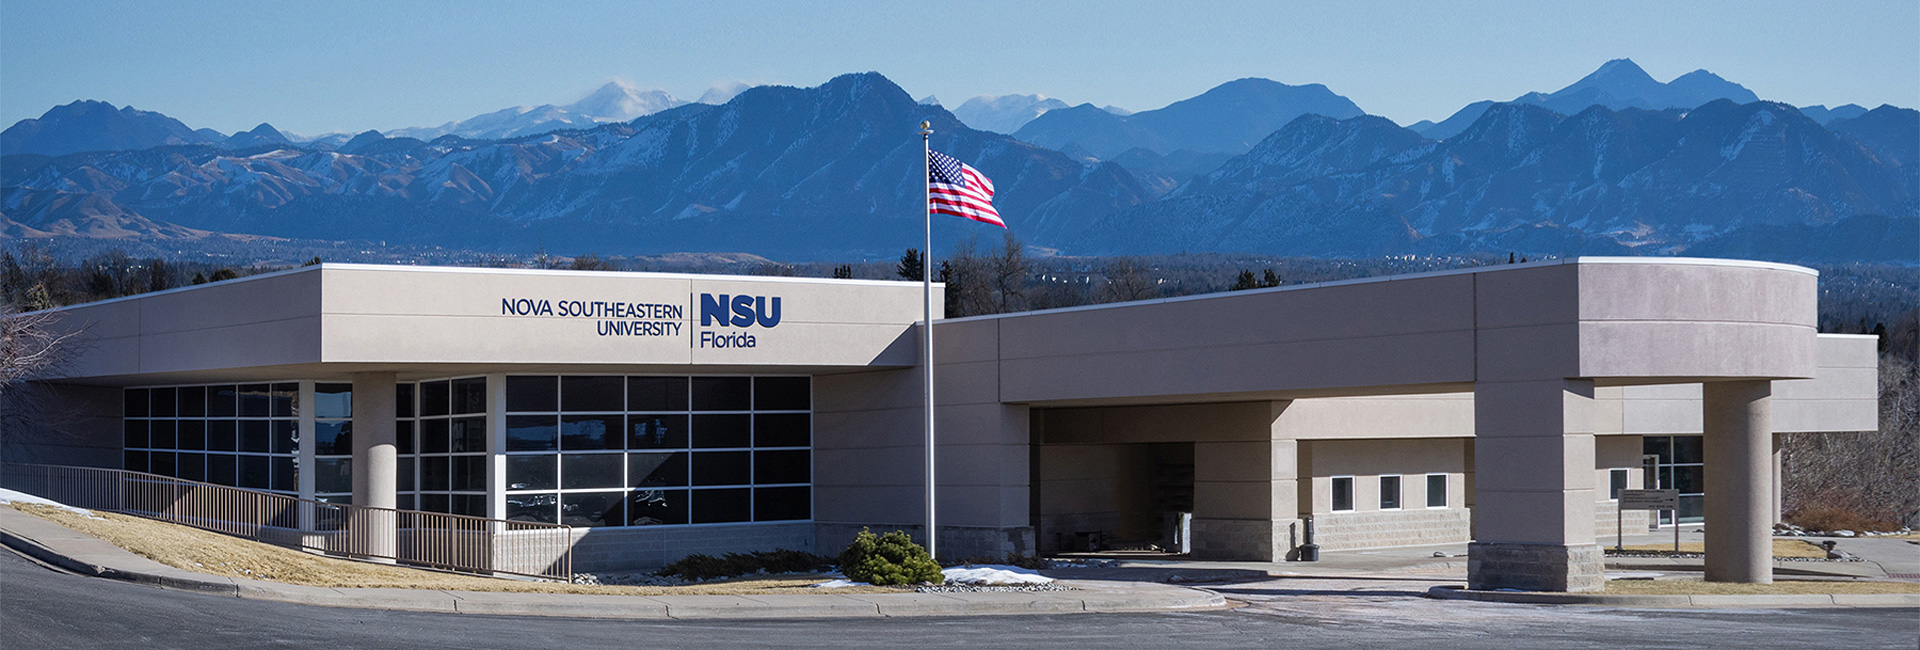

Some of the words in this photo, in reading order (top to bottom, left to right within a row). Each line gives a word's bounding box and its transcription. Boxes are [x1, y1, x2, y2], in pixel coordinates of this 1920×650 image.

[501, 298, 553, 316] NOVA
[558, 300, 683, 319] SOUTHEASTERN
[700, 293, 782, 328] NSU
[597, 320, 683, 337] UNIVERSITY
[701, 331, 756, 348] Florida
